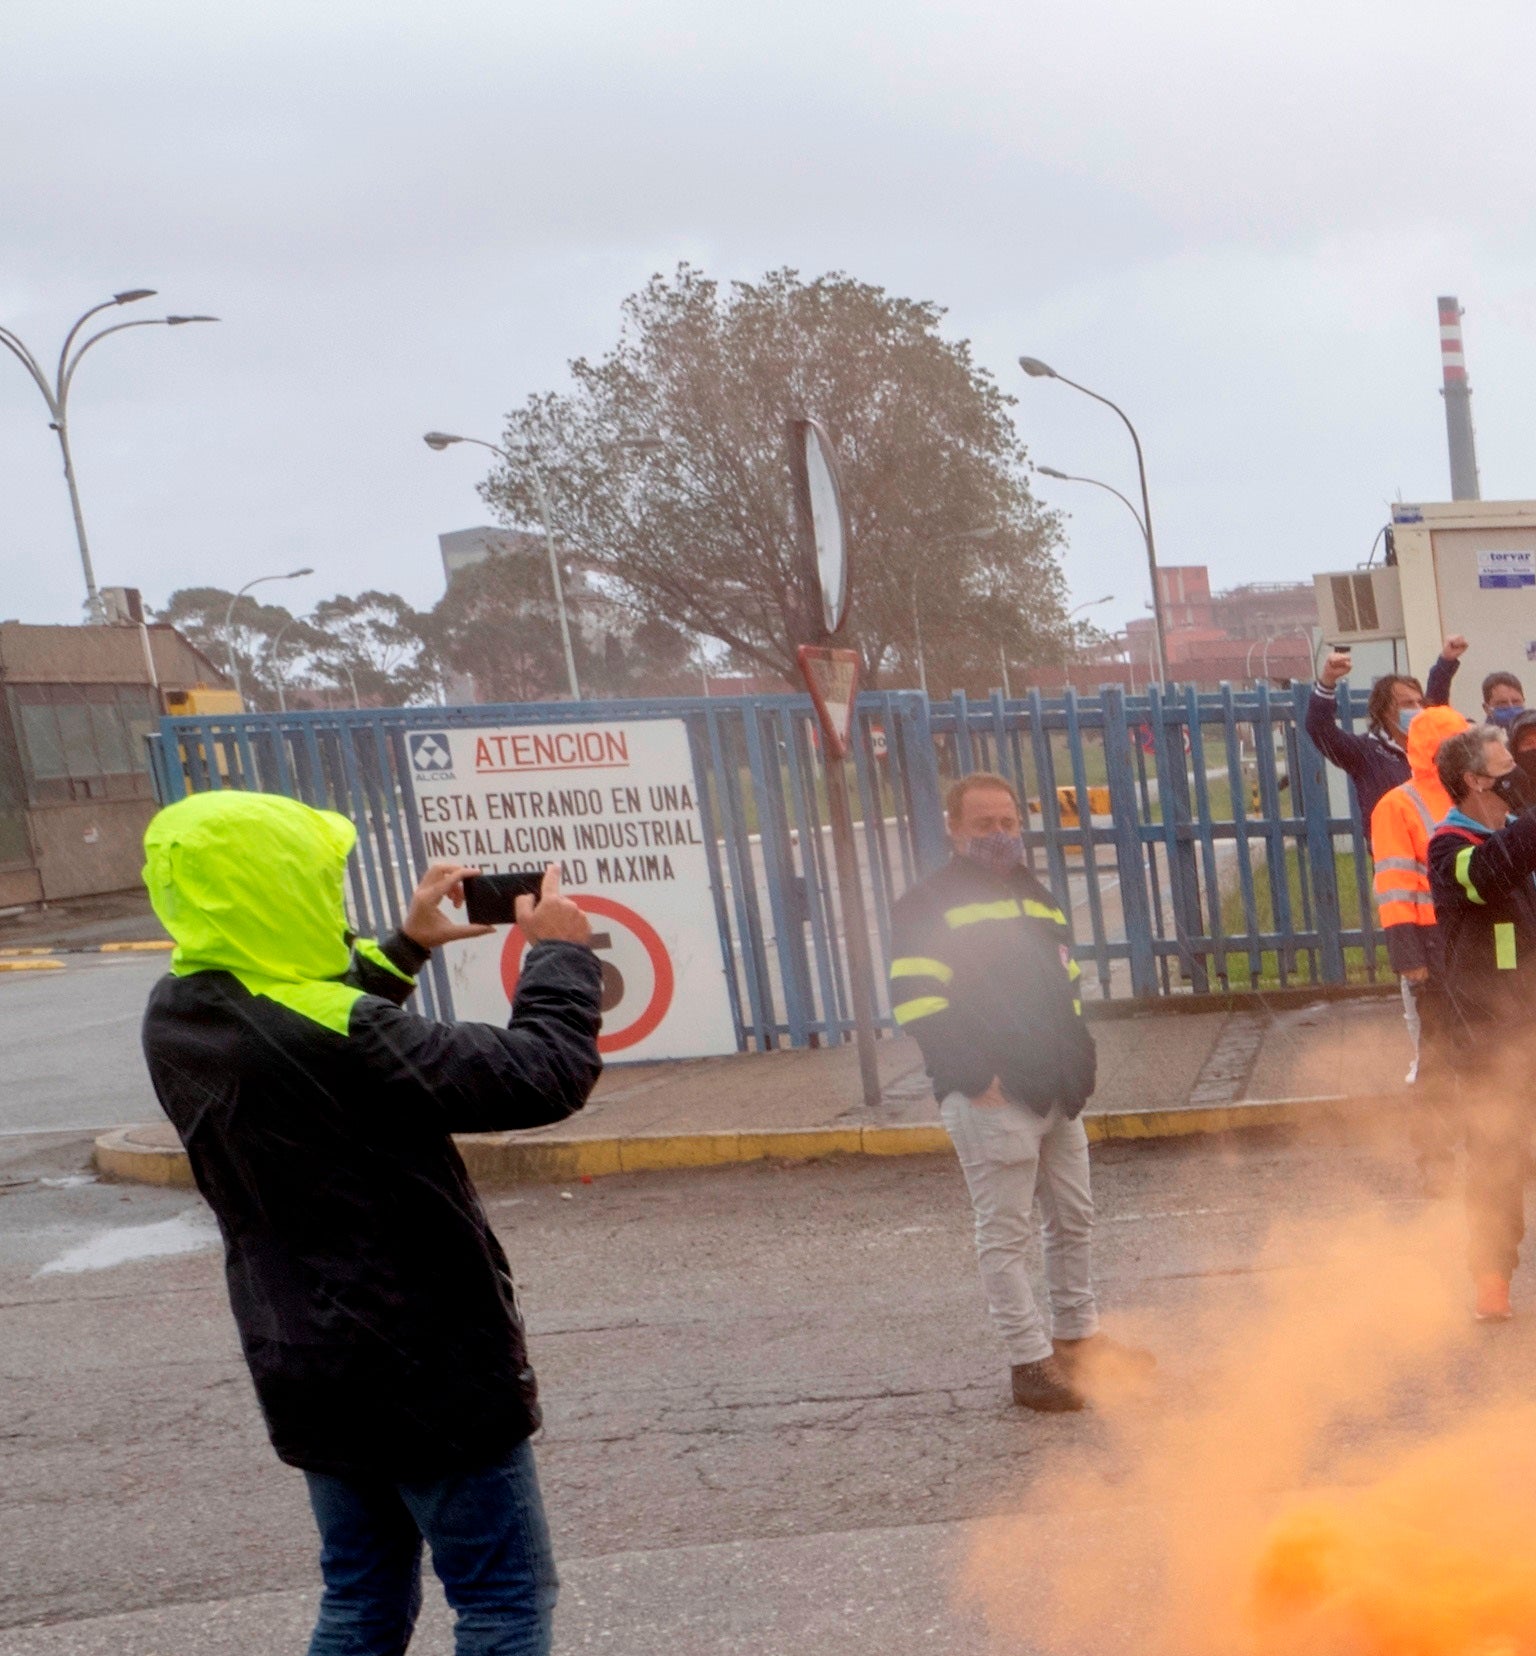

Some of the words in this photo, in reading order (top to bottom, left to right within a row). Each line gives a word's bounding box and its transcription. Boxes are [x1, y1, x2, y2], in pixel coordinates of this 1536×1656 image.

[1490, 552, 1531, 561] torvar
[475, 731, 629, 767] ATENCION
[415, 772, 457, 782] ALCOA
[421, 794, 477, 822] ESTA
[485, 790, 603, 820] ENTRANDO
[611, 787, 642, 815] EN
[648, 784, 694, 812] UNA
[424, 825, 567, 858] INSTALACION
[573, 819, 703, 850] INDUSTRIAL
[597, 855, 676, 884] MAXIMA
